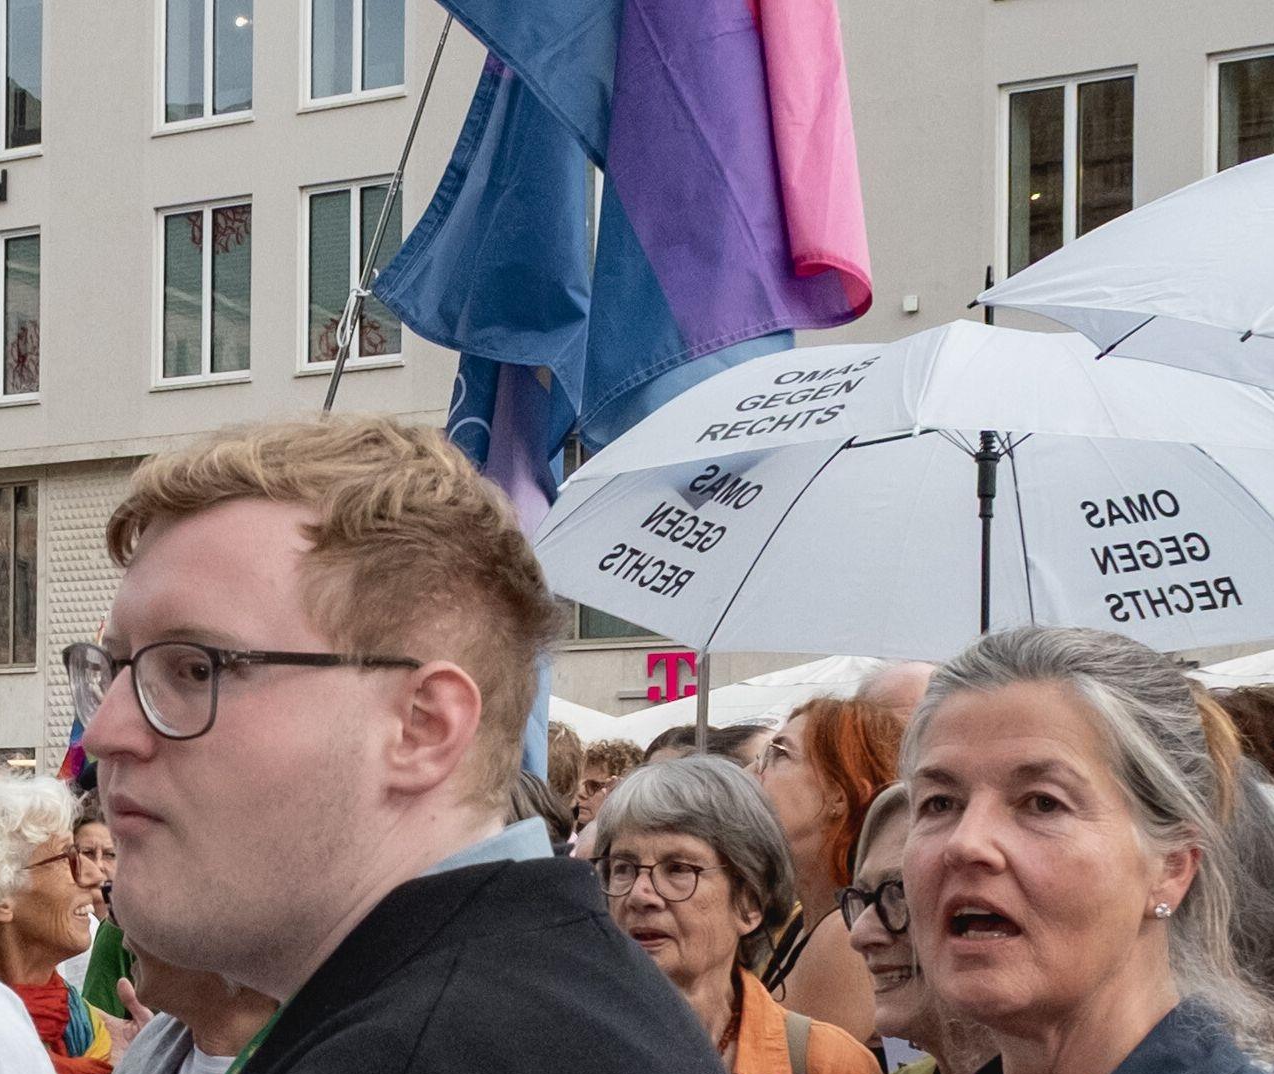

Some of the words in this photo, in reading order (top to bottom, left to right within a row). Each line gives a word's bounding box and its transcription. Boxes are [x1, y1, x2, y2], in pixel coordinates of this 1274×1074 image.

[774, 356, 881, 385] OMAS
[736, 377, 866, 412] GEGEN
[695, 404, 846, 443] RECHTS
